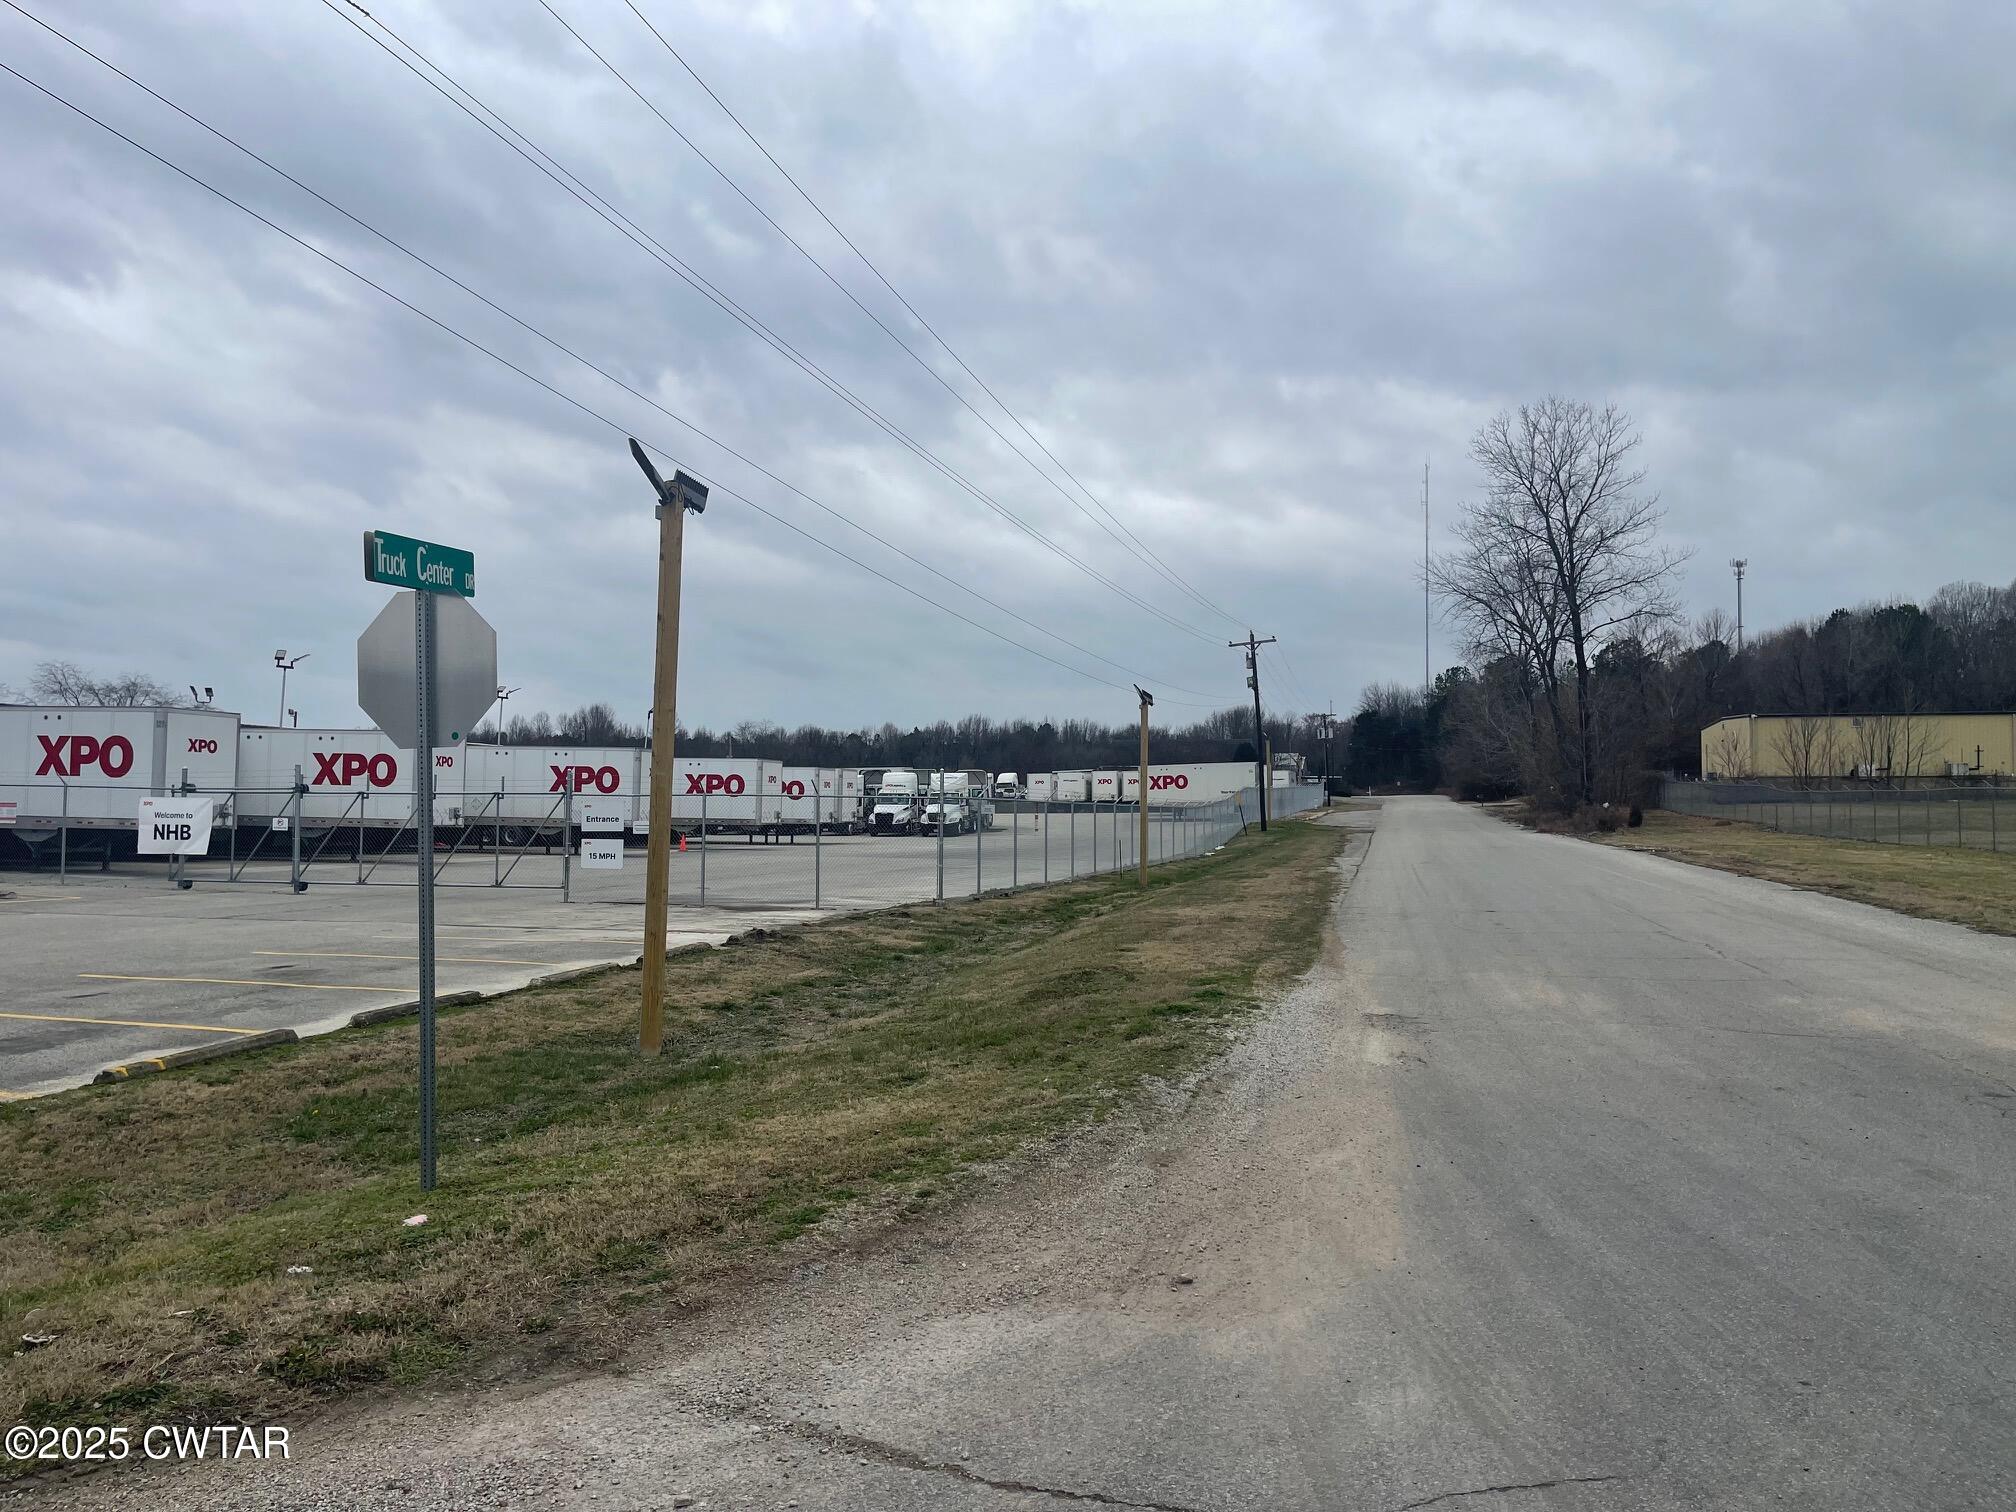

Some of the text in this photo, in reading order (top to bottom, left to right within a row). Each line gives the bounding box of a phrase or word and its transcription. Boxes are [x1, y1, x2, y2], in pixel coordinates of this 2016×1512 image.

[374, 538, 407, 578] Truck
[416, 546, 455, 586] Center
[187, 738, 218, 754] XPO
[35, 735, 134, 778] XPO
[435, 755, 453, 768] XPO
[312, 752, 397, 787] XPO
[549, 765, 620, 794] XPO
[685, 773, 746, 797] XPO
[768, 776, 777, 784] XPO
[1149, 774, 1188, 790] XPO
[154, 811, 185, 819] Welcome
[586, 815, 620, 823] Entrance
[153, 823, 192, 841] NHB
[589, 852, 597, 860] 15
